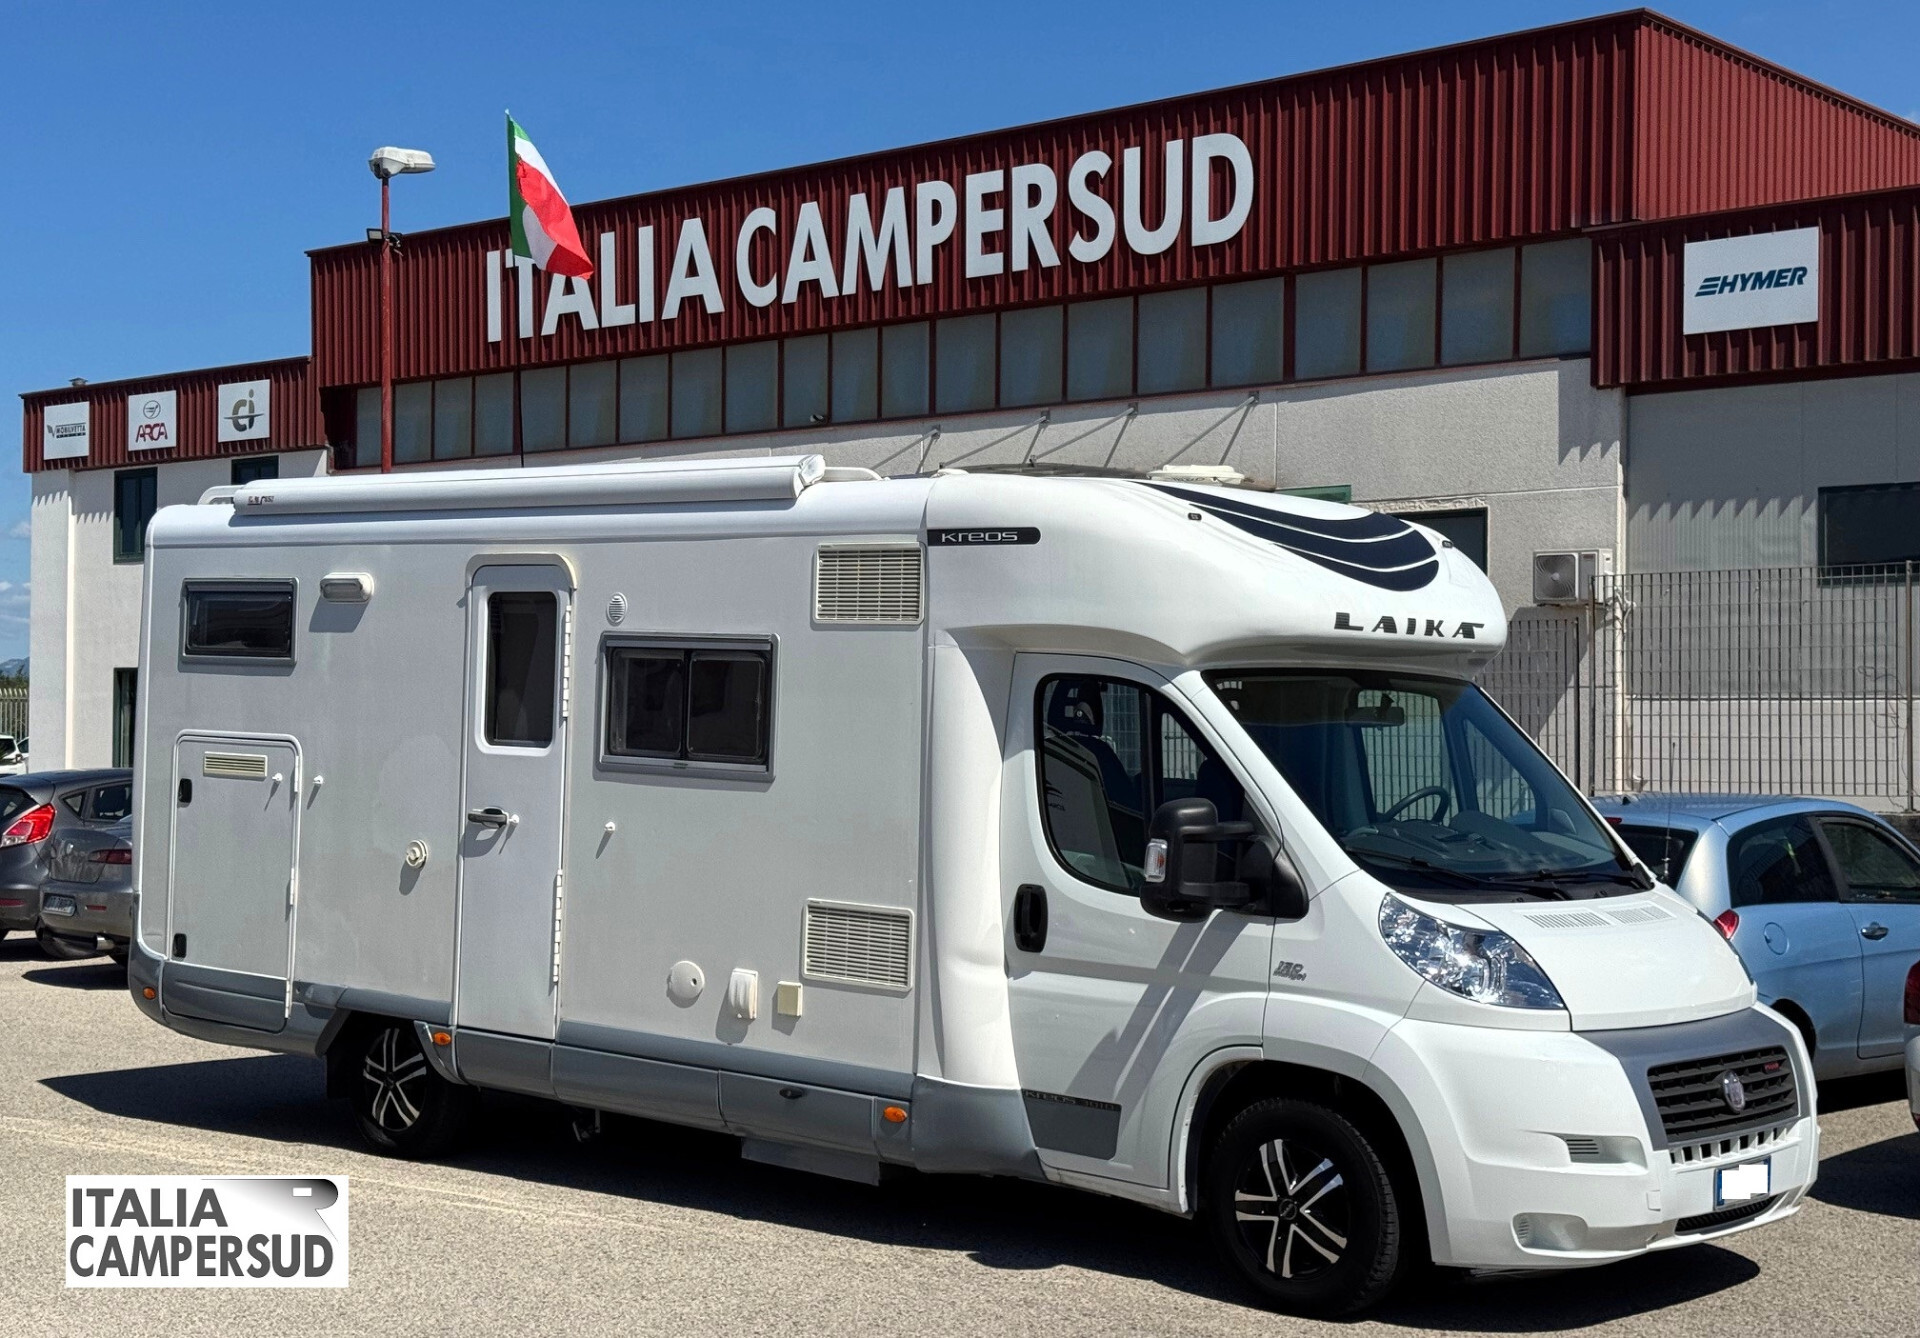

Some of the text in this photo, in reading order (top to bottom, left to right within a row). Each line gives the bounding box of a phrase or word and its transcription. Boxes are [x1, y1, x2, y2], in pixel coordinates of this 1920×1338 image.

[487, 133, 1254, 343] ITALIA CAMPERSUD
[135, 422, 168, 443] ARCA
[1334, 612, 1485, 639] LAIKA
